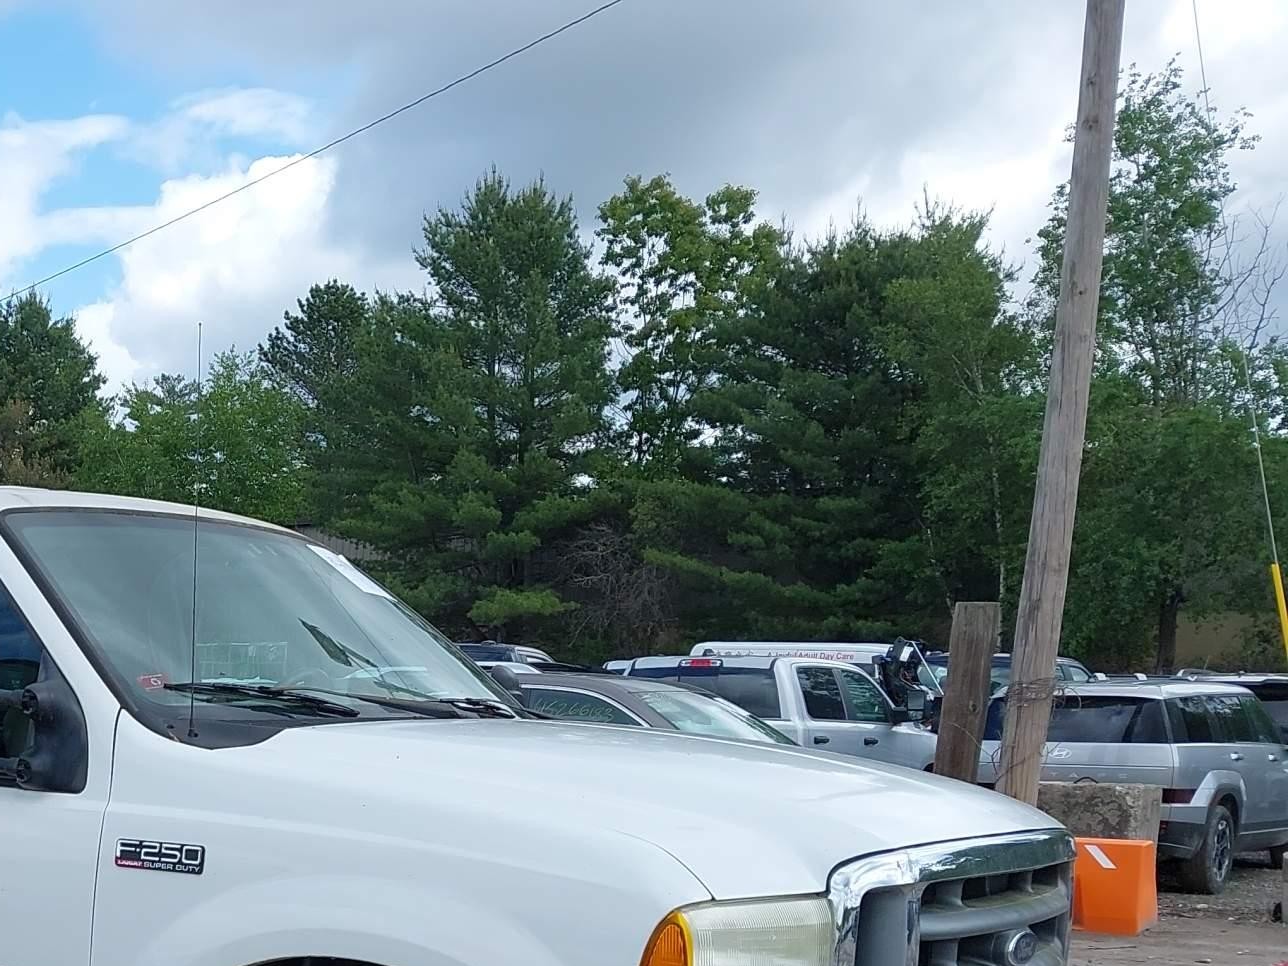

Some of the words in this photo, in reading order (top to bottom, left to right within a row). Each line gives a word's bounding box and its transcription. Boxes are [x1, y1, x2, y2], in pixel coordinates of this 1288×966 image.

[819, 652, 835, 661] Day
[836, 652, 855, 660] Care
[143, 861, 173, 870] SUPER
[175, 864, 200, 873] DUTY
